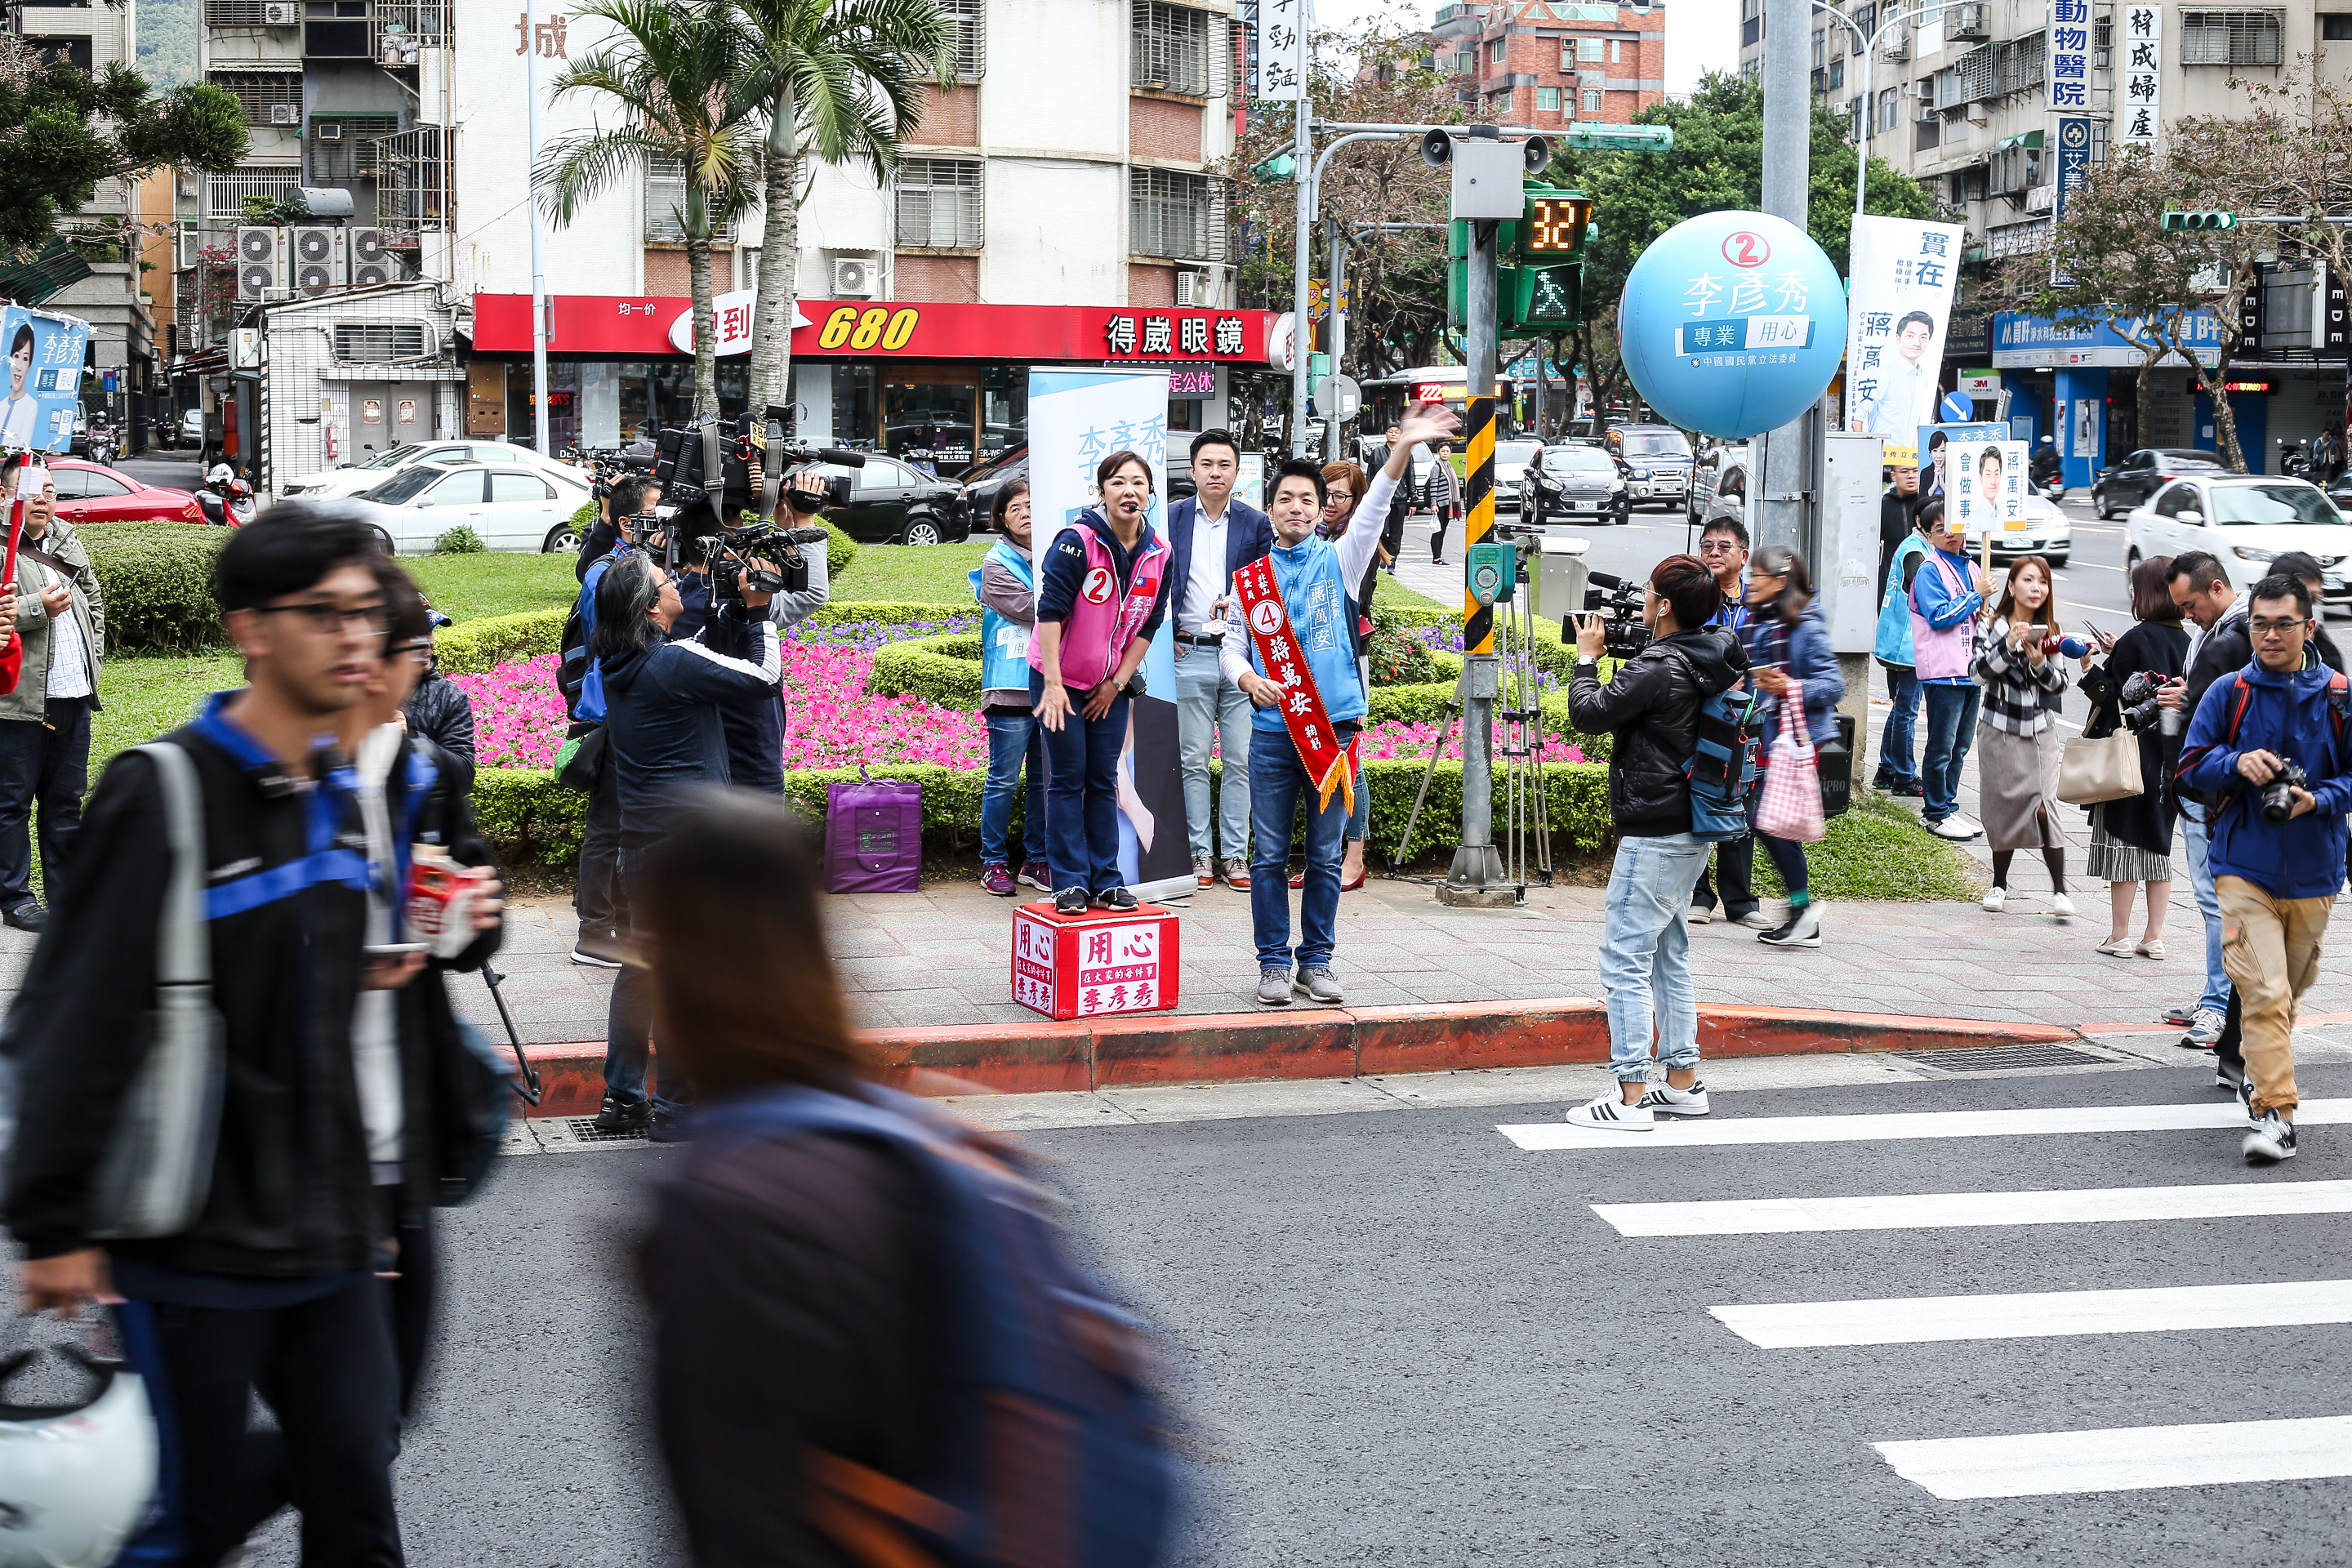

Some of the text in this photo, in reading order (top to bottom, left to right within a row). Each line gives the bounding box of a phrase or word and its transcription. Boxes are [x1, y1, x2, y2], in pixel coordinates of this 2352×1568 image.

[514, 13, 568, 59] 城
[1532, 201, 1575, 250] 32
[1736, 234, 1758, 264] 2
[1682, 268, 1810, 317] 李彥秀
[817, 305, 920, 351] 680
[1106, 314, 1245, 354] 得崴眼鏡
[1693, 319, 1798, 347] 專業 用心
[42, 332, 83, 365] 李彥秀
[1703, 353, 1797, 368] 中國國民黨立法委員
[1858, 311, 1894, 403] 蔣萬安
[1419, 384, 1443, 402] 222
[1973, 380, 1988, 388] 3M
[2007, 452, 2020, 518] 蔣萬安
[1089, 571, 1107, 602] 2
[1327, 577, 1341, 620] 立法委員
[1261, 604, 1276, 627] 4
[1309, 585, 1331, 647] 蔣萬安
[1013, 643, 1028, 655] 用
[1269, 635, 1312, 717] 蔣萬安
[1304, 724, 1322, 751] 鞠躬
[1019, 924, 1050, 961] 用心
[1087, 931, 1153, 965] 用心
[1083, 964, 1154, 984] 在大家的每件事
[1018, 976, 1051, 1011] 李彥秀
[1083, 982, 1155, 1013] 李彥秀
